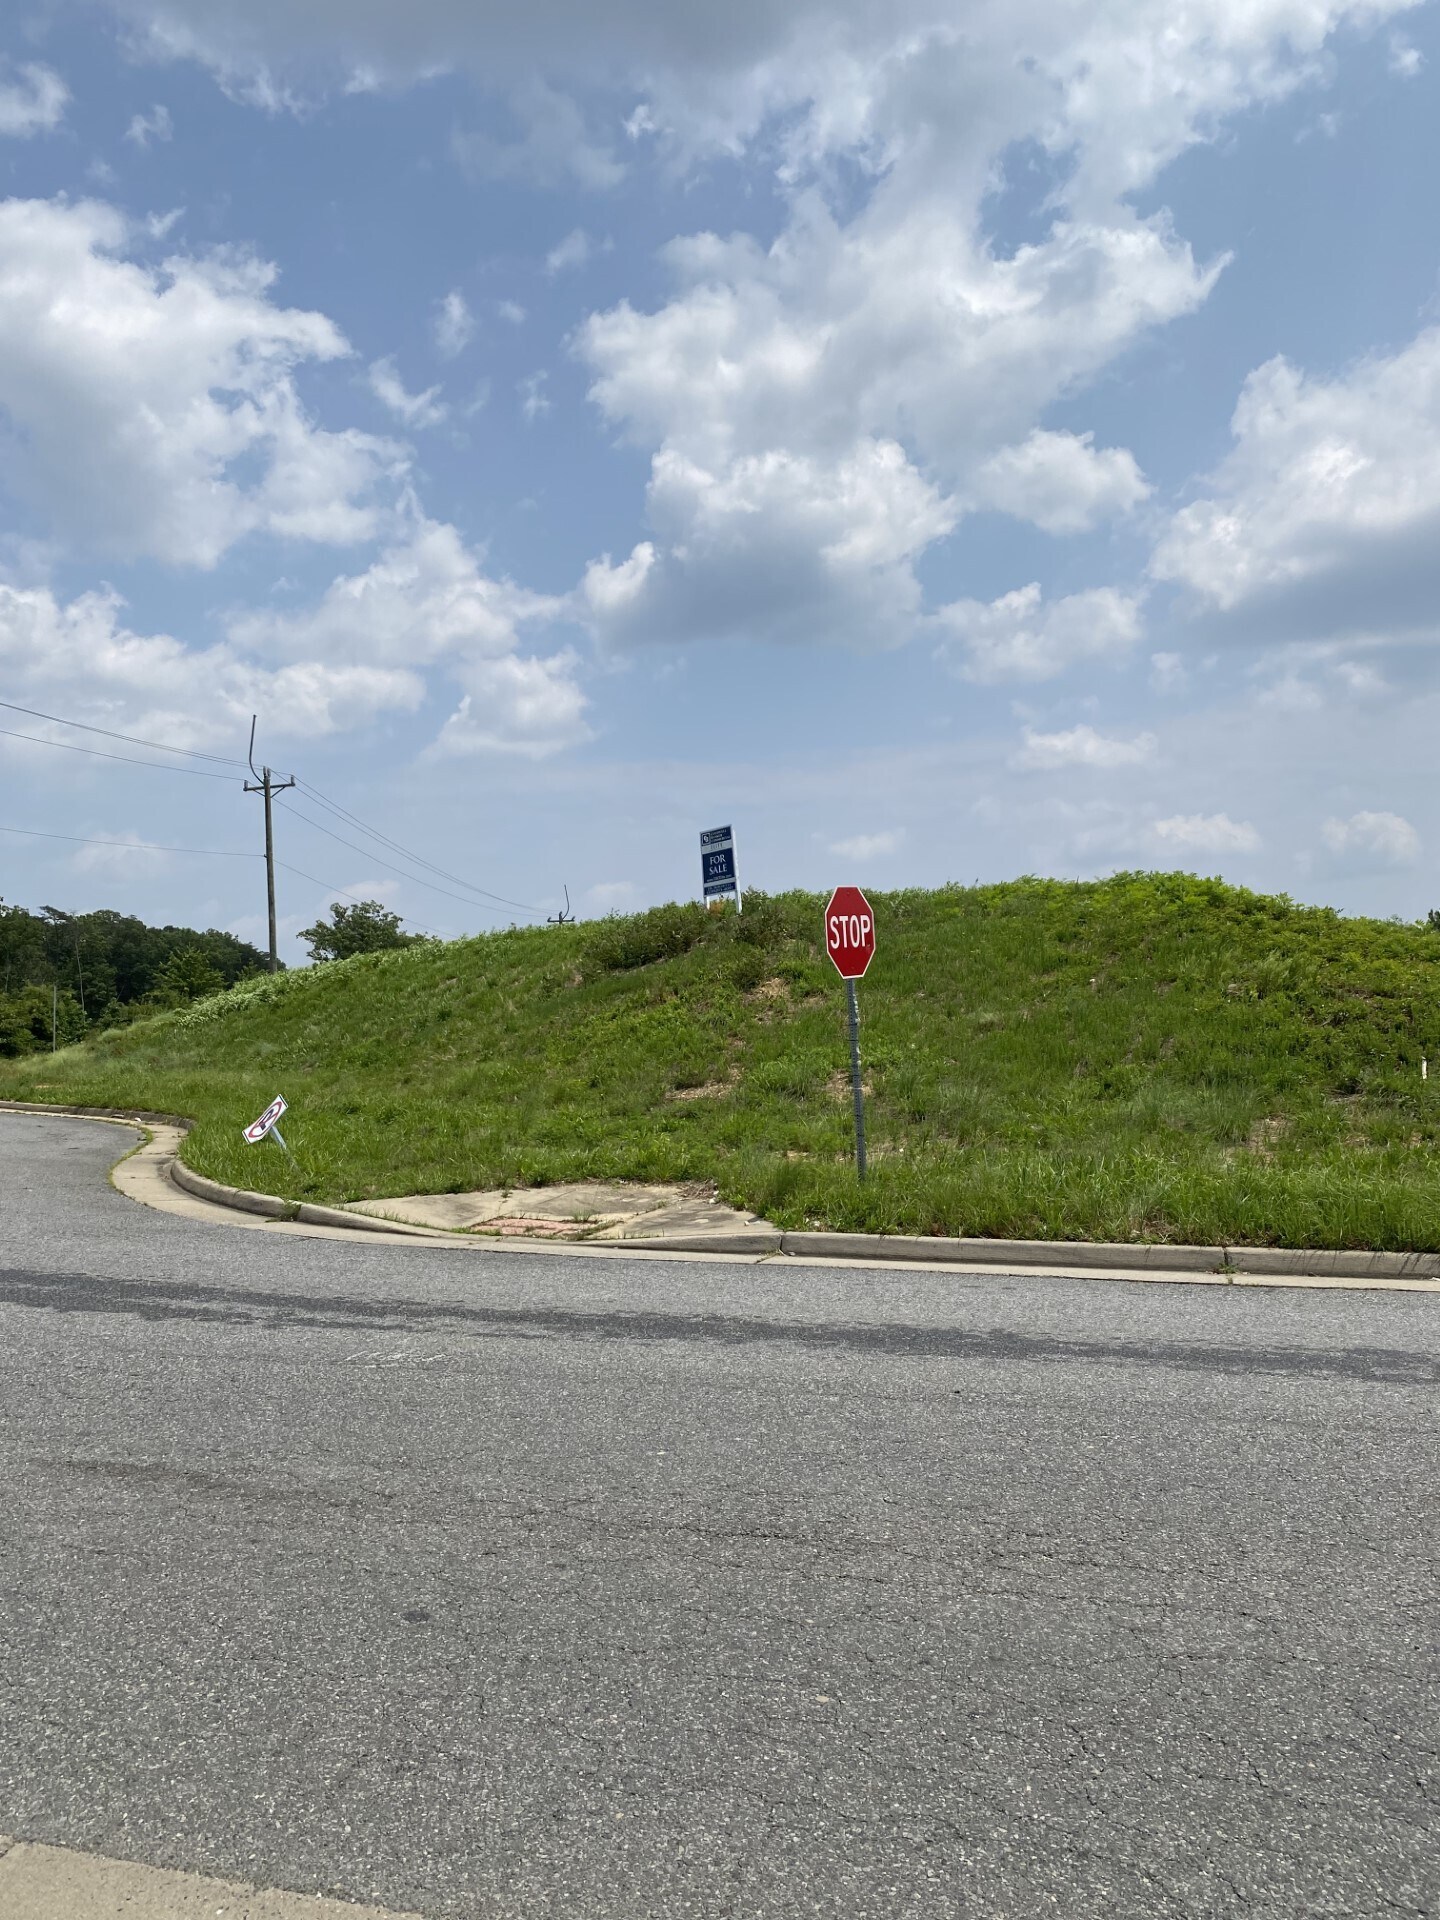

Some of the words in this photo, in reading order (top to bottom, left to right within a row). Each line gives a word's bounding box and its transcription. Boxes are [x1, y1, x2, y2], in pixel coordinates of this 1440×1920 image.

[710, 854, 726, 865] FOR
[709, 864, 727, 875] SALE
[830, 914, 871, 949] STOP
